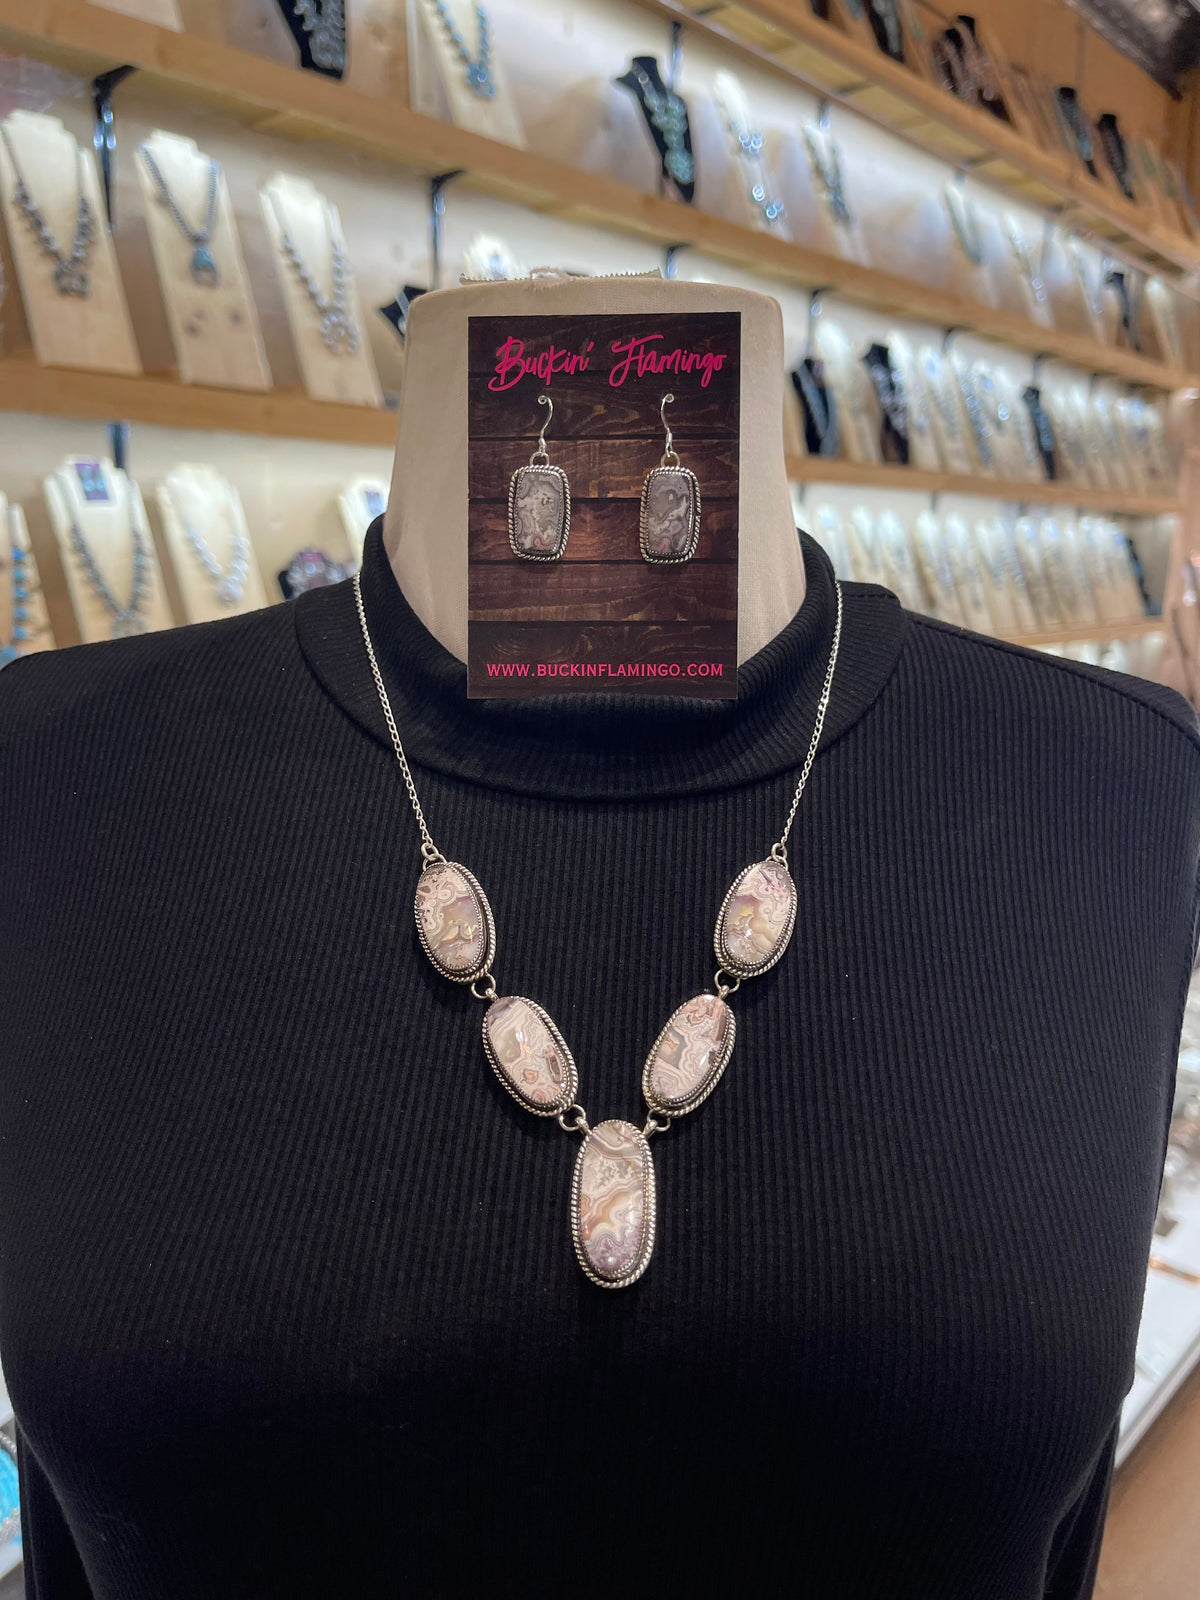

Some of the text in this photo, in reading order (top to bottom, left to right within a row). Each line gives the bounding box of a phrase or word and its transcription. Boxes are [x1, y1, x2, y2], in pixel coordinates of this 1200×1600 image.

[488, 334, 727, 391] Buckin' Flamingo
[486, 663, 723, 677] WWW.BUCKINFLAMINGO.COM
